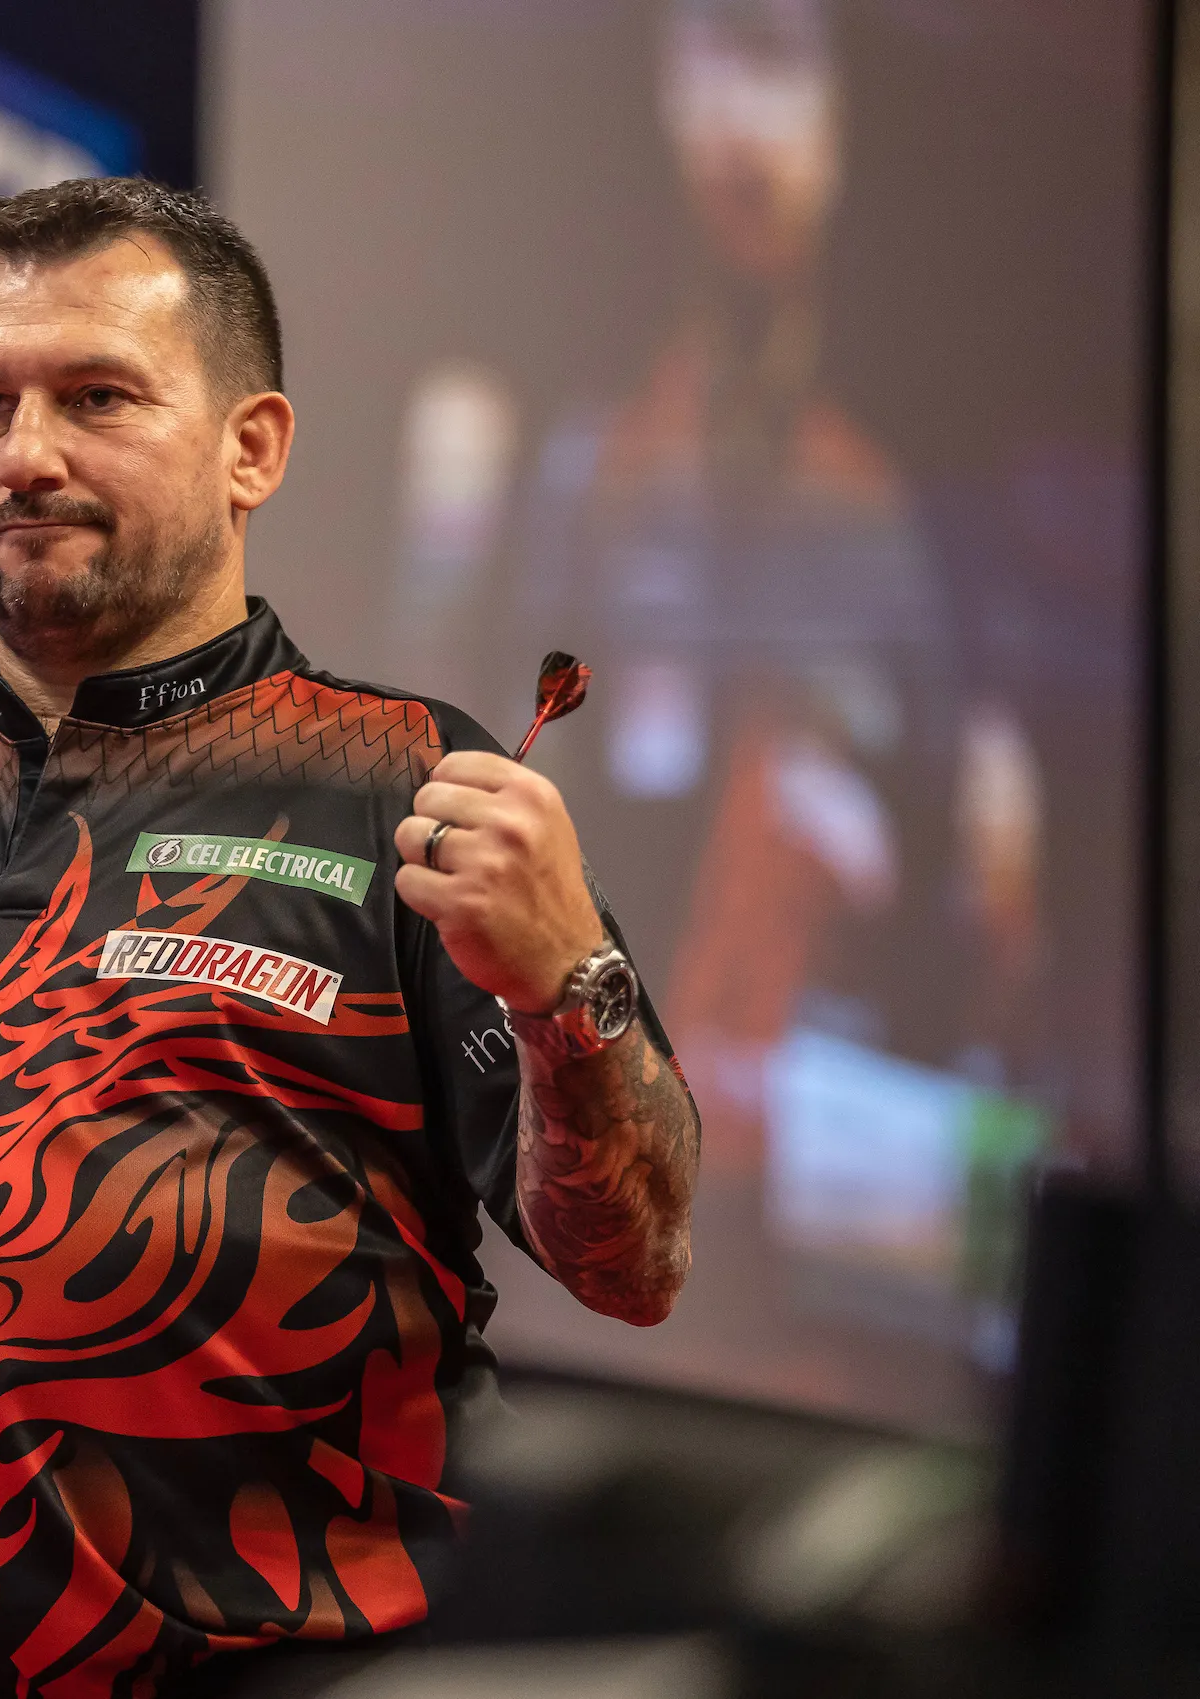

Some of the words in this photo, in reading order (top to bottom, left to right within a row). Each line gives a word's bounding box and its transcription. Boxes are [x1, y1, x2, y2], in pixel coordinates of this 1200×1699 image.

[139, 677, 207, 710] Ffion
[186, 843, 221, 866] CEL
[226, 845, 355, 893] ELECTRICAL
